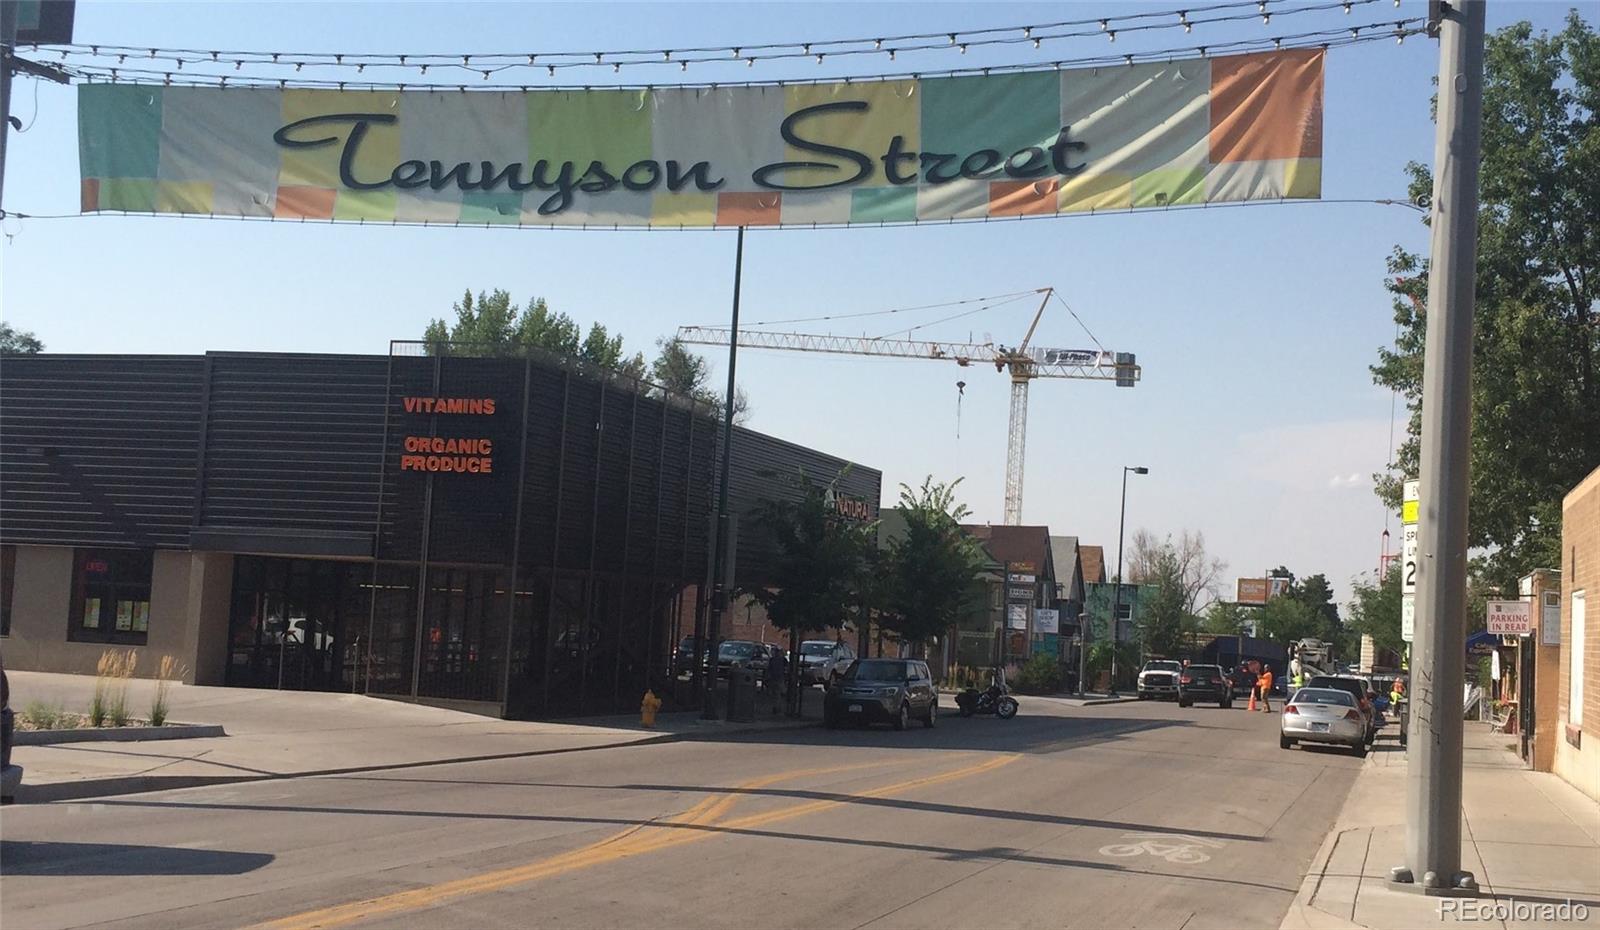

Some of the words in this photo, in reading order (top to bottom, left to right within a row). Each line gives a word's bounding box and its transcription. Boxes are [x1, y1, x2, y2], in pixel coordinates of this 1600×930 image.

[272, 112, 725, 216] Tennyson
[751, 100, 1089, 190] Street
[403, 397, 496, 415] VITAMINS
[404, 436, 493, 455] ORGANIC
[400, 454, 493, 473] PRODUCE
[1406, 561, 1416, 586] 2
[1490, 614, 1529, 623] PARKING
[1492, 623, 1502, 632] IN
[1504, 623, 1528, 632] REAR
